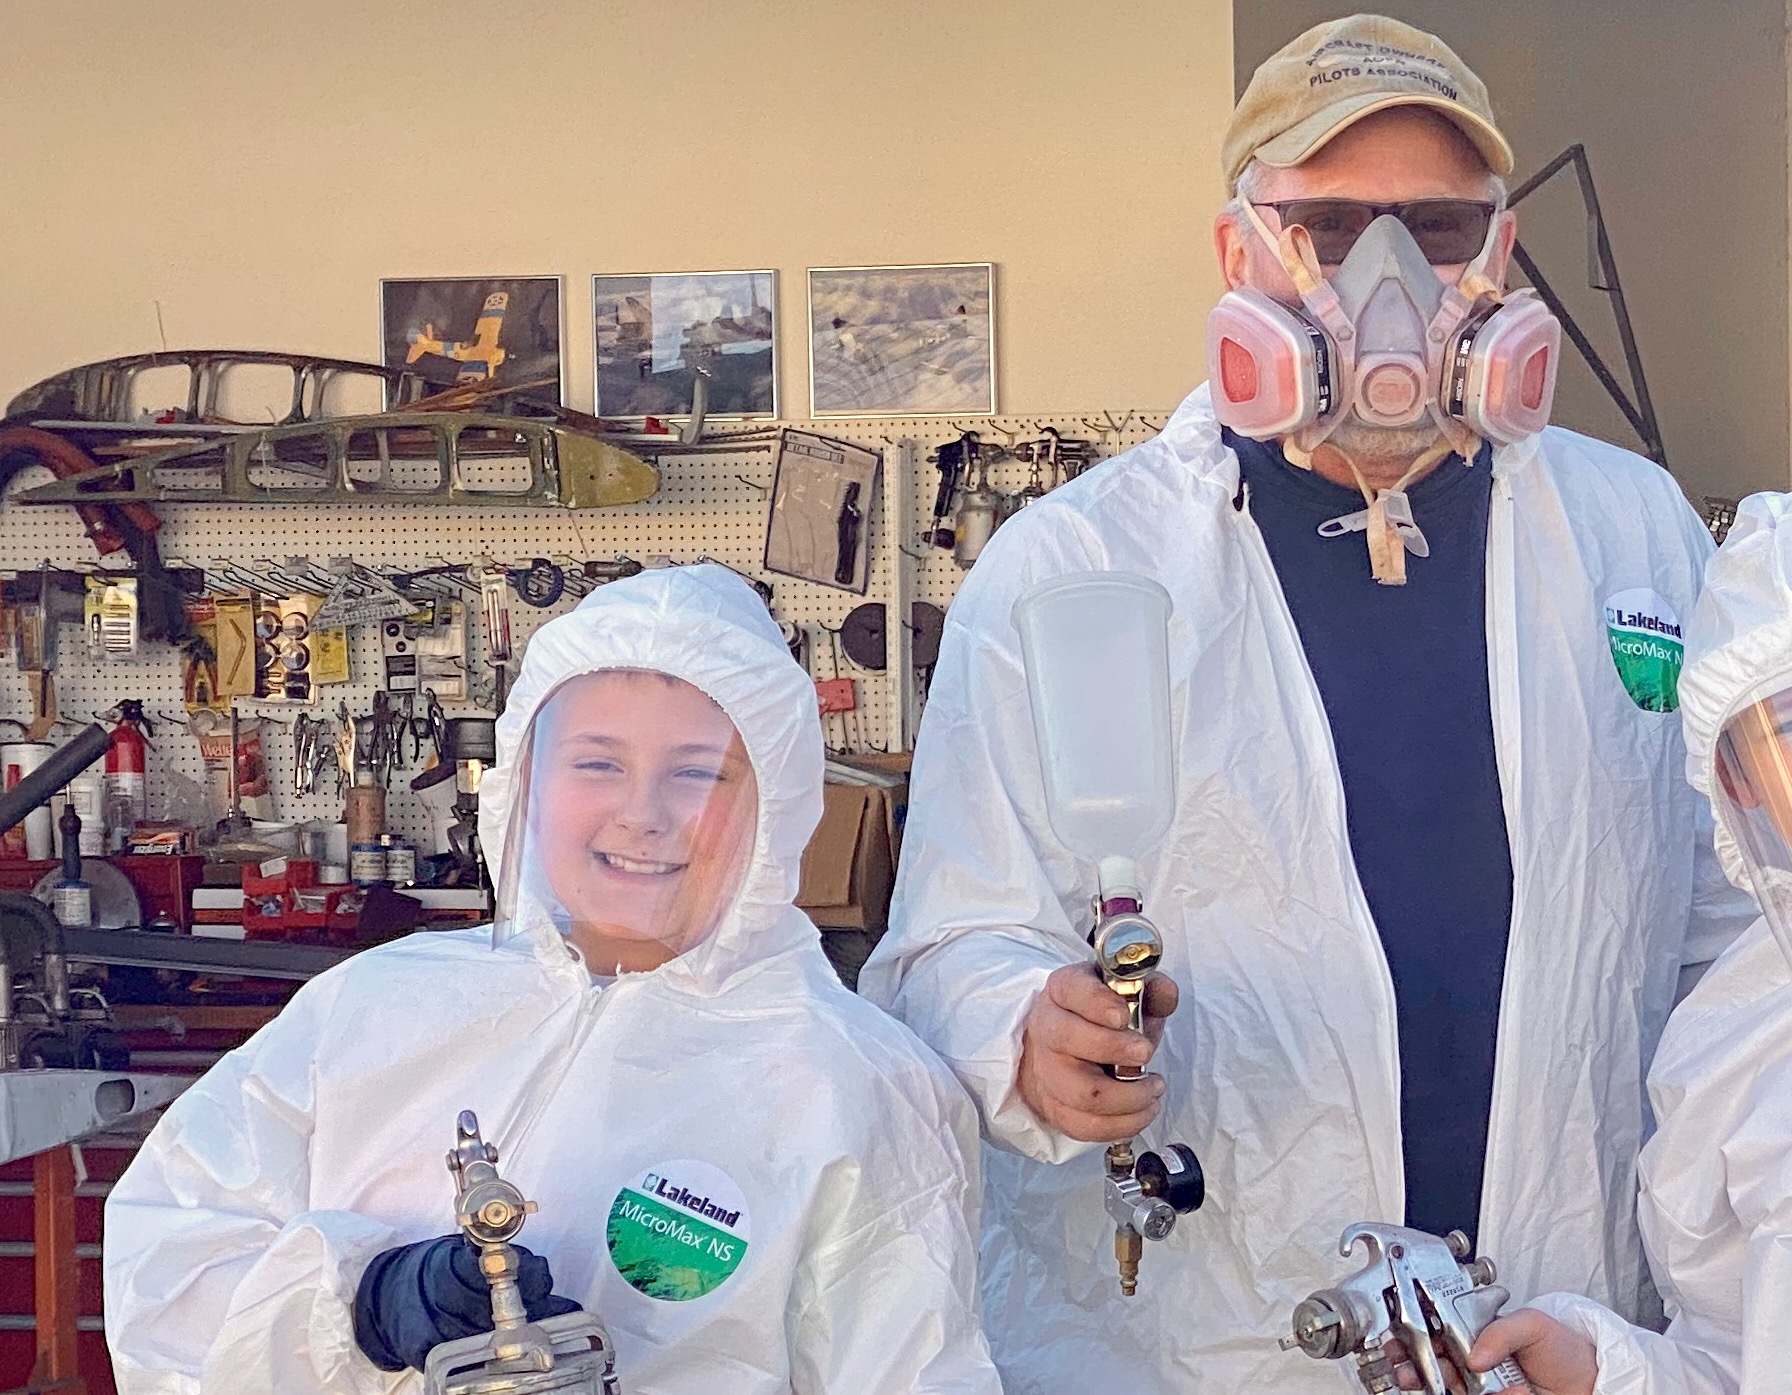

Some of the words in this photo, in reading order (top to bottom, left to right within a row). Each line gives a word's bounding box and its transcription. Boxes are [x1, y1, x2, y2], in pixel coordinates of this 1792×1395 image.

[1309, 67, 1361, 88] PILOTS
[1366, 68, 1458, 101] ASSOCIATION
[1616, 609, 1682, 640] Lakeland
[654, 1177, 741, 1228] Lakeland
[618, 1200, 702, 1249] MicroMax
[706, 1238, 735, 1262] NS
